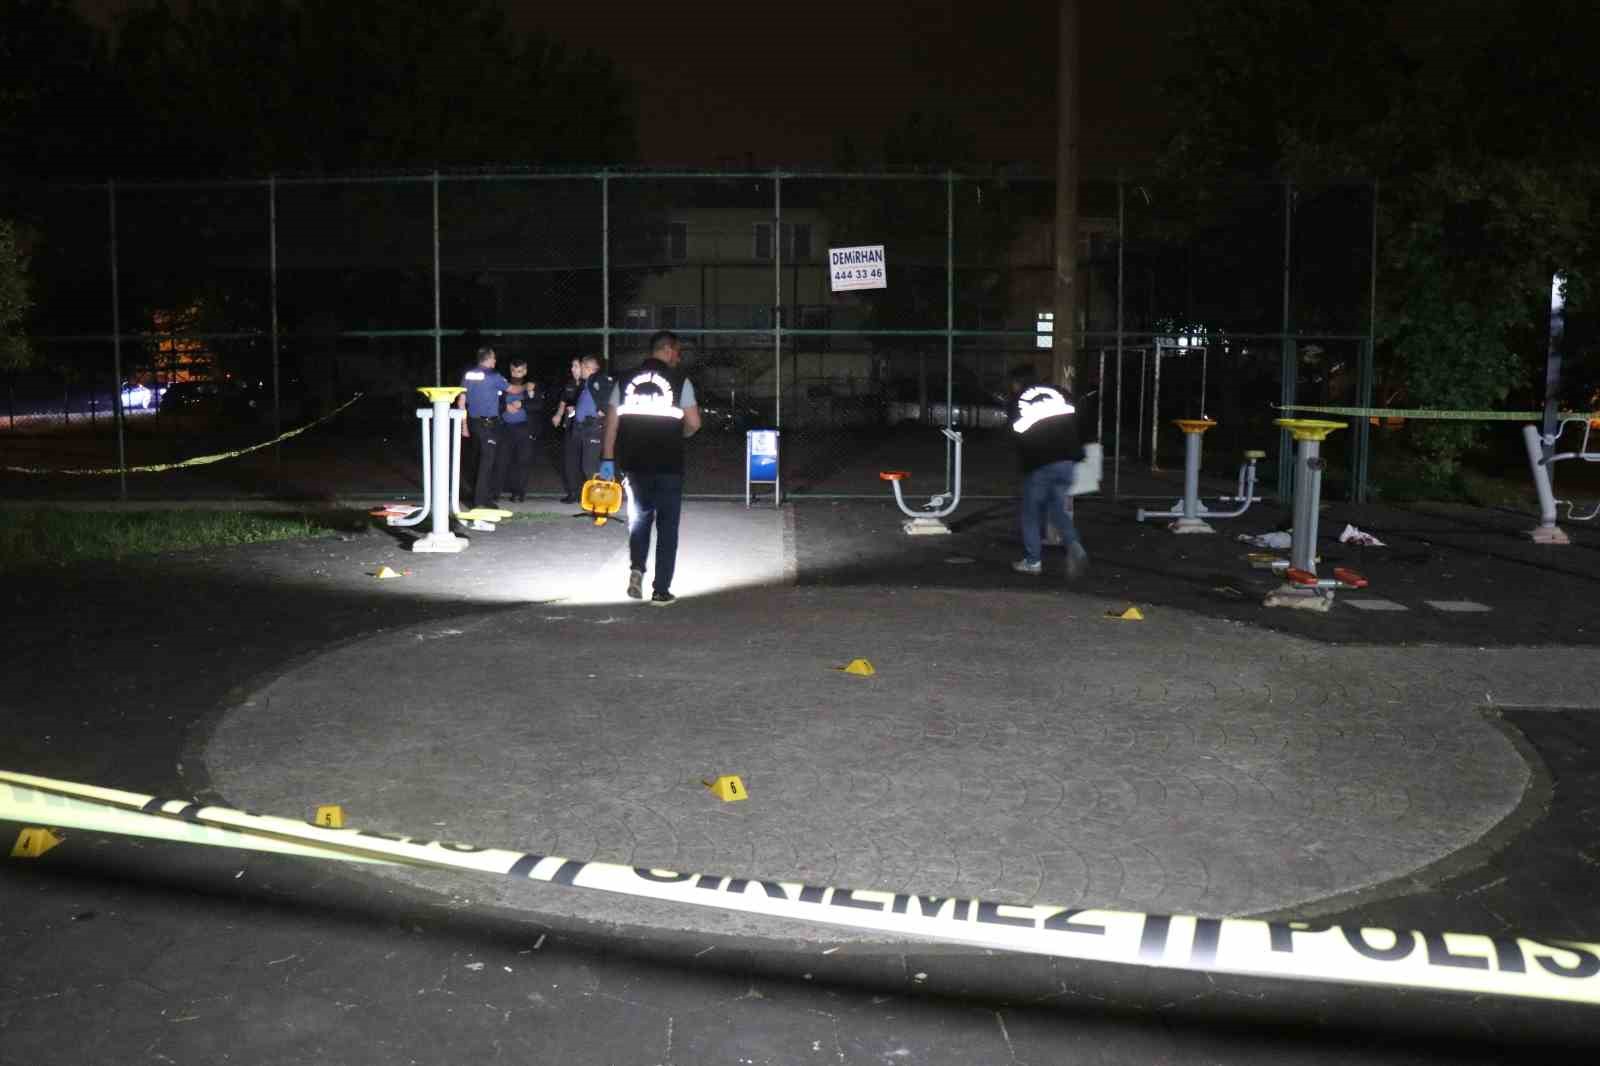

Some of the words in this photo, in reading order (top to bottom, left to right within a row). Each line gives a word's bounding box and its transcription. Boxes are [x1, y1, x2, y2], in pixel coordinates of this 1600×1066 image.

[834, 270, 853, 280] 444
[855, 269, 868, 279] 33
[870, 268, 883, 278] 46
